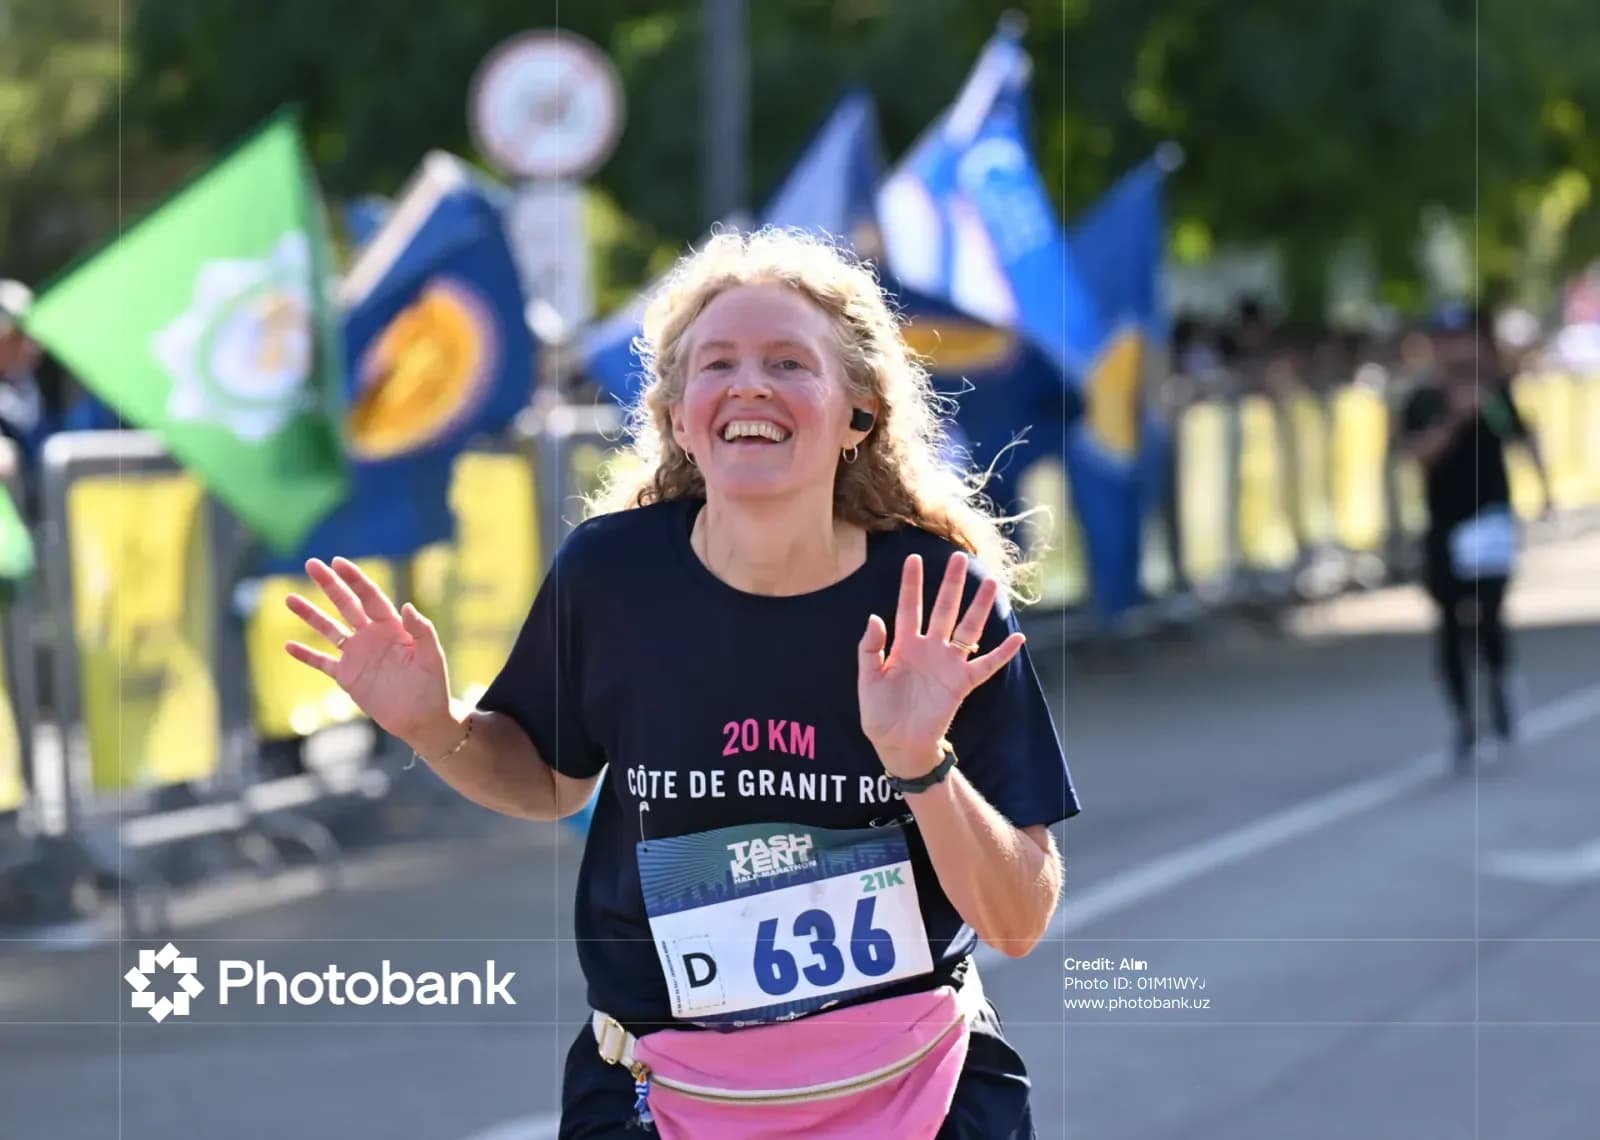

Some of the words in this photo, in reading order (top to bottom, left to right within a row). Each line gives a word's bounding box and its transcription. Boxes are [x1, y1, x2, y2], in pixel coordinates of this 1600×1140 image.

[722, 718, 760, 757] 20
[768, 719, 816, 760] KM
[627, 764, 678, 799] CÔTE
[689, 769, 725, 798] DE
[738, 769, 847, 803] GRANIT
[726, 833, 813, 864] TASH
[730, 846, 809, 879] KENT
[734, 859, 817, 885] HALF-MARATHON
[860, 867, 905, 893] 21K
[753, 895, 896, 996] 636
[682, 952, 717, 989] D
